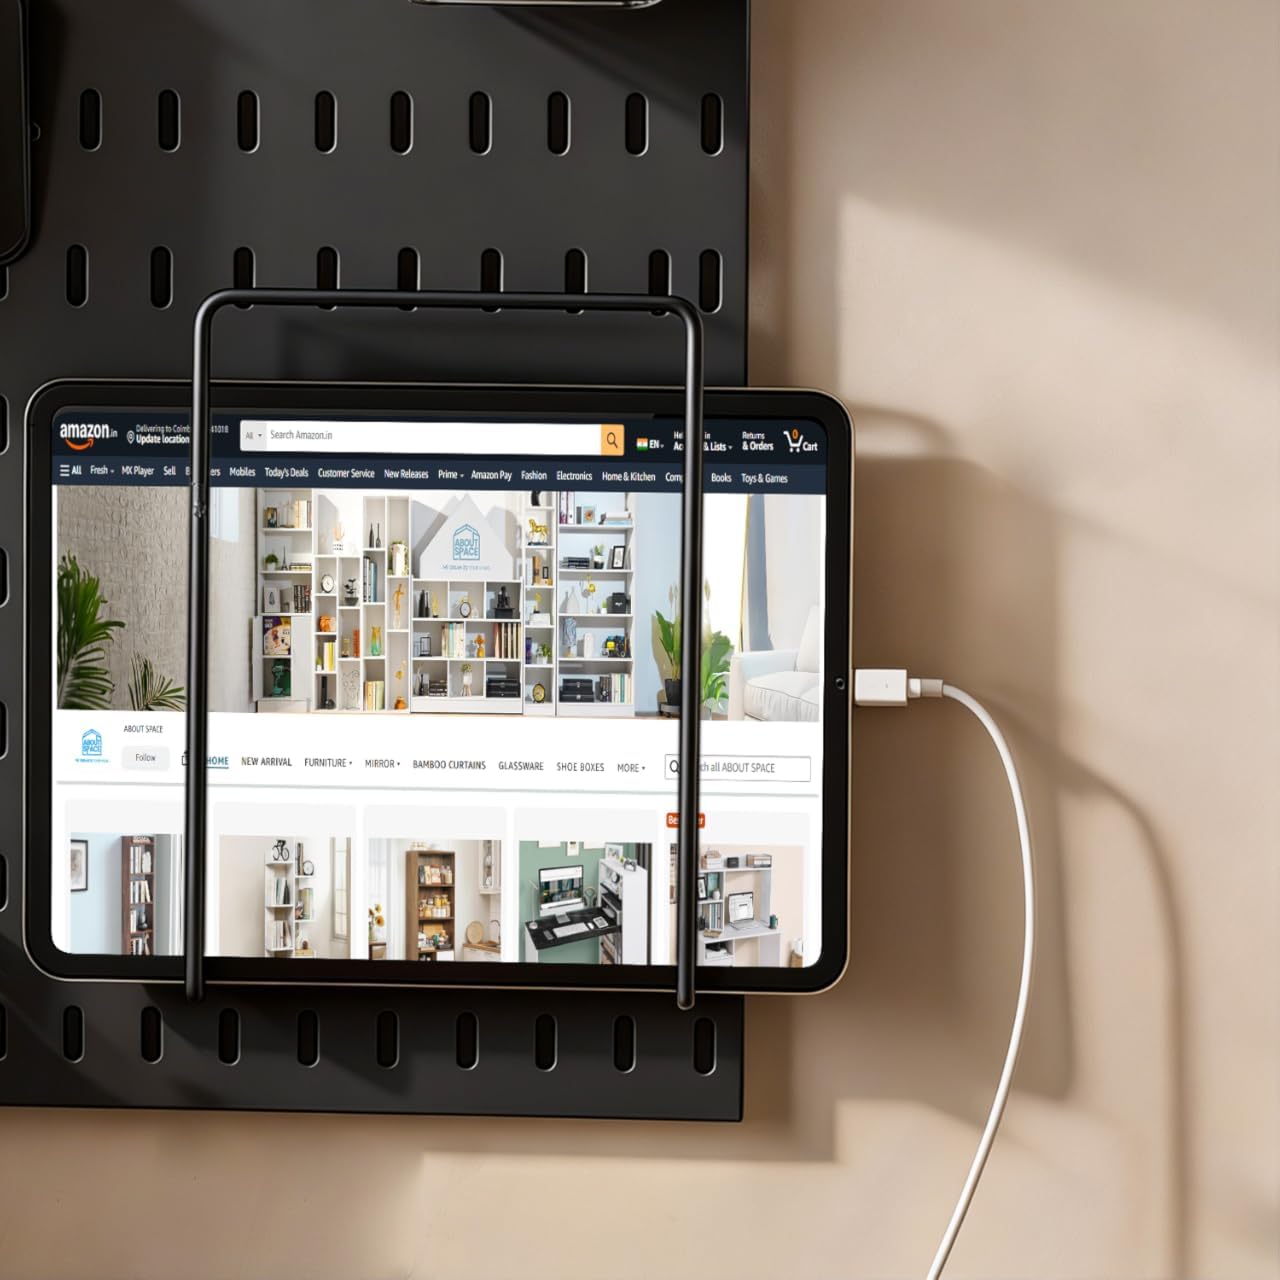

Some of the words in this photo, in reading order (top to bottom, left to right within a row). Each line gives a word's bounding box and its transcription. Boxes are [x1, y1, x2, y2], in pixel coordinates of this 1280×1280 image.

[59, 423, 118, 439] amazon.in
[136, 424, 163, 434] Delivering
[165, 425, 172, 433] to
[791, 428, 799, 440] 0
[136, 434, 161, 445] Update
[162, 434, 190, 444] location
[245, 432, 254, 440] All
[270, 430, 294, 440] Search
[295, 431, 333, 440] Amazon.in
[742, 431, 765, 440] Returns
[649, 439, 660, 449] EN
[710, 442, 727, 452] Lists
[742, 441, 749, 451] &
[750, 441, 774, 451] Orders
[802, 441, 819, 452] Cart
[71, 465, 82, 475] All
[90, 465, 109, 475] Fresh
[122, 466, 133, 475] MX
[134, 466, 154, 477] Player
[163, 466, 176, 476] Sell
[229, 466, 256, 477] Mobiles
[264, 467, 289, 479] Today's
[290, 467, 309, 477] Deals
[317, 468, 349, 478] Customer
[351, 468, 375, 478] Service
[384, 469, 399, 479] New
[400, 469, 429, 479] Releases
[438, 470, 458, 479] Prime
[521, 470, 548, 480] Fashion
[471, 470, 499, 480] Amazon
[500, 470, 513, 482] Pay
[556, 471, 592, 481] Electronics
[602, 472, 622, 481] Home
[623, 472, 629, 481] &
[630, 472, 656, 482] Kitchen
[711, 472, 732, 483] Books
[741, 473, 756, 485] Toys
[757, 473, 764, 483] &
[765, 473, 788, 484] Games
[455, 538, 478, 547] ABOUT
[455, 547, 479, 556] SPACE
[124, 724, 145, 734] ABOUT
[146, 725, 163, 734] SPACE
[135, 753, 156, 762] Follow
[206, 756, 229, 766] HOME
[241, 756, 259, 766] NEW
[260, 757, 292, 767] ARRIVAL
[304, 758, 347, 767] FURNITURE
[365, 759, 395, 769] MIRROR
[412, 760, 447, 769] BAMBOO
[448, 760, 486, 770] CURTAINS
[498, 761, 544, 771] GLASSWARE
[556, 762, 578, 772] SHOE
[580, 762, 605, 772] BOXES
[617, 763, 639, 773] MORE
[710, 762, 720, 772] all
[721, 762, 749, 773] ABOUT
[751, 763, 776, 773] SPACE
